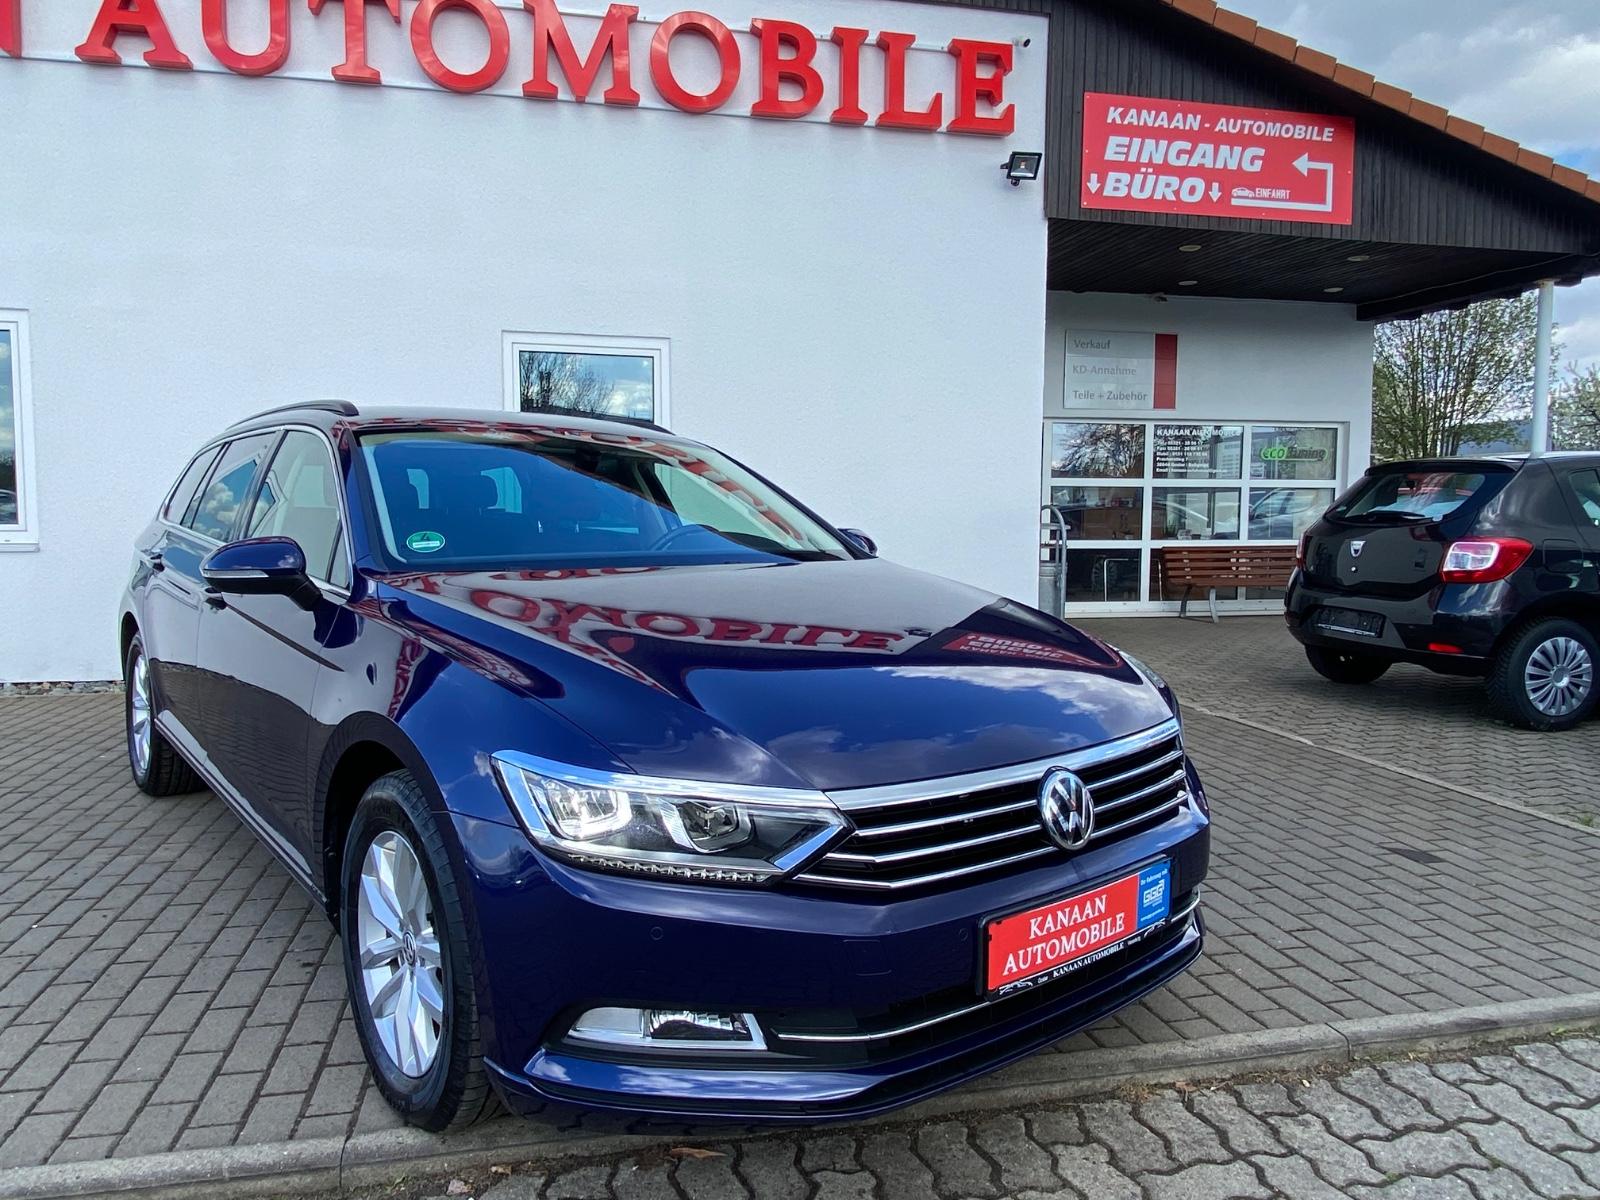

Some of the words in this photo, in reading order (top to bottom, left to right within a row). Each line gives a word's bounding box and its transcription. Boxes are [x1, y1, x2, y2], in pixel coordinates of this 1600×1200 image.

[74, 0, 1015, 137] AUTOMOBILE
[1106, 106, 1202, 131] KANAAN
[1214, 117, 1335, 143] AUTOMOBILE
[1103, 135, 1266, 172] EINGANG
[1102, 167, 1206, 203] BÜRO
[1255, 187, 1290, 200] EINFAHRT
[1073, 339, 1111, 350] Verkauf
[1072, 365, 1137, 376] KD-Annahme
[1072, 390, 1095, 400] Teile
[1105, 390, 1148, 401] Zubehör
[1028, 894, 1107, 940] KANAAN
[1002, 912, 1126, 977] AUTOMOBILE
